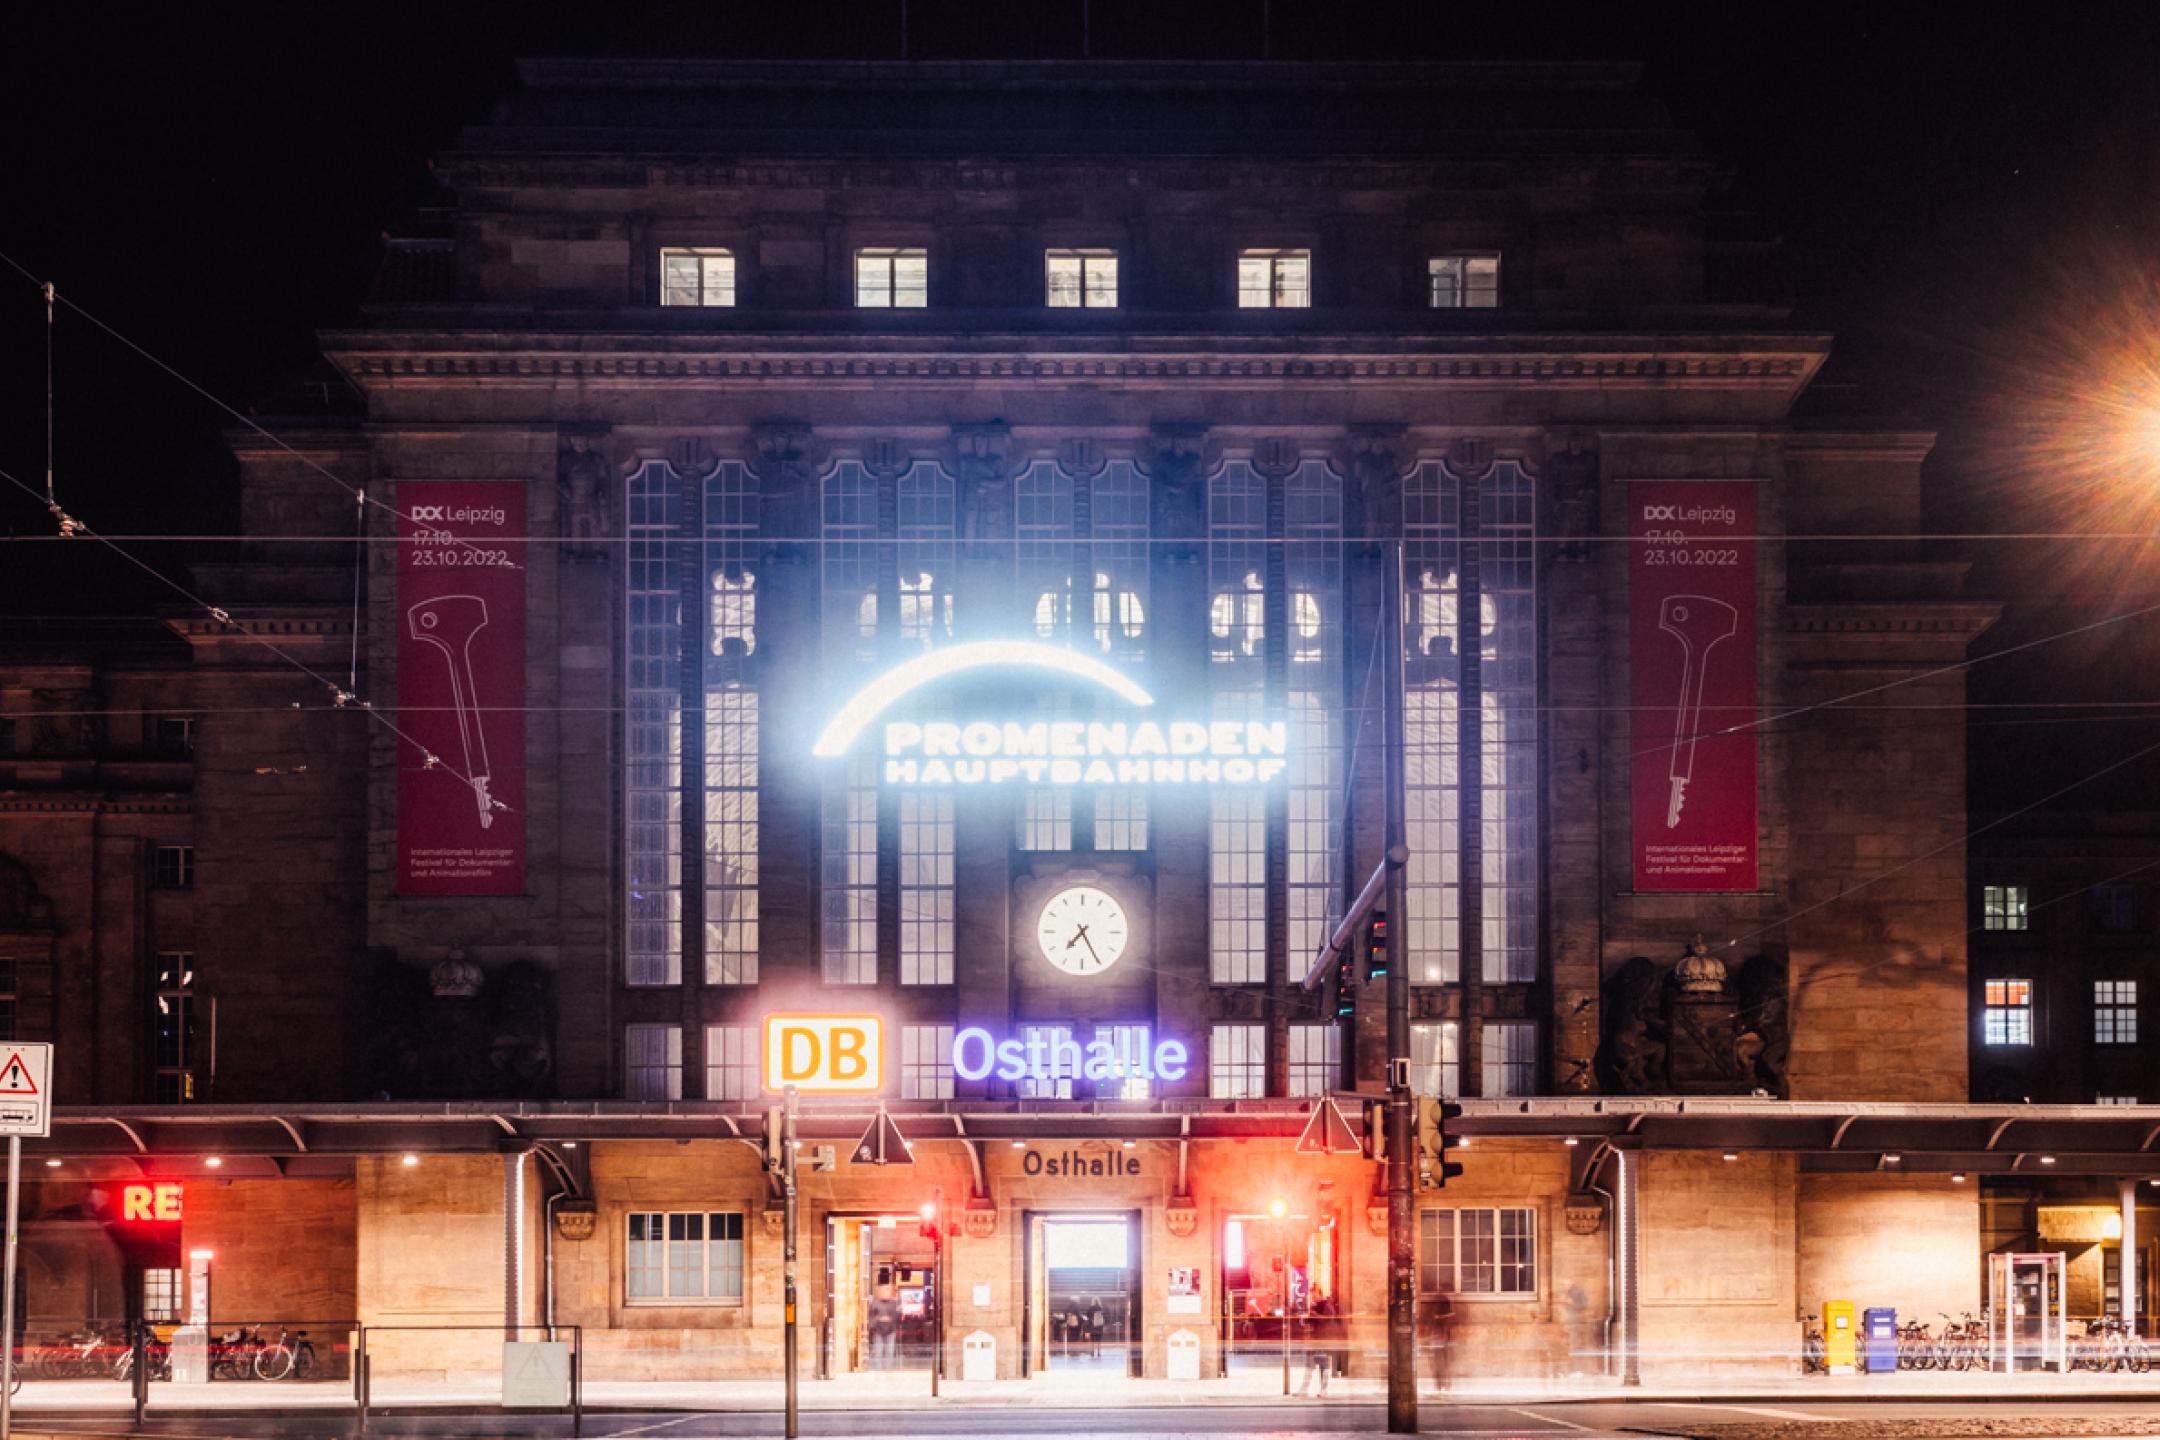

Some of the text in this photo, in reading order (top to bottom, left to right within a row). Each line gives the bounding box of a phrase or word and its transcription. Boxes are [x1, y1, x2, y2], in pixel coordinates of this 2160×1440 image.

[447, 506, 505, 525] Leipzig
[1678, 506, 1736, 525] Leipzig
[886, 721, 1287, 756] PROMENADEN
[886, 758, 1287, 783] HAUPTBAHNHOF
[1645, 855, 1678, 864] Festival
[1709, 845, 1747, 855] Leipziger
[410, 858, 442, 867] Festival
[1645, 866, 1663, 874] und
[780, 1026, 869, 1082] DB
[952, 1026, 1189, 1082] Osthalle
[1022, 1150, 1142, 1176] Osthalle
